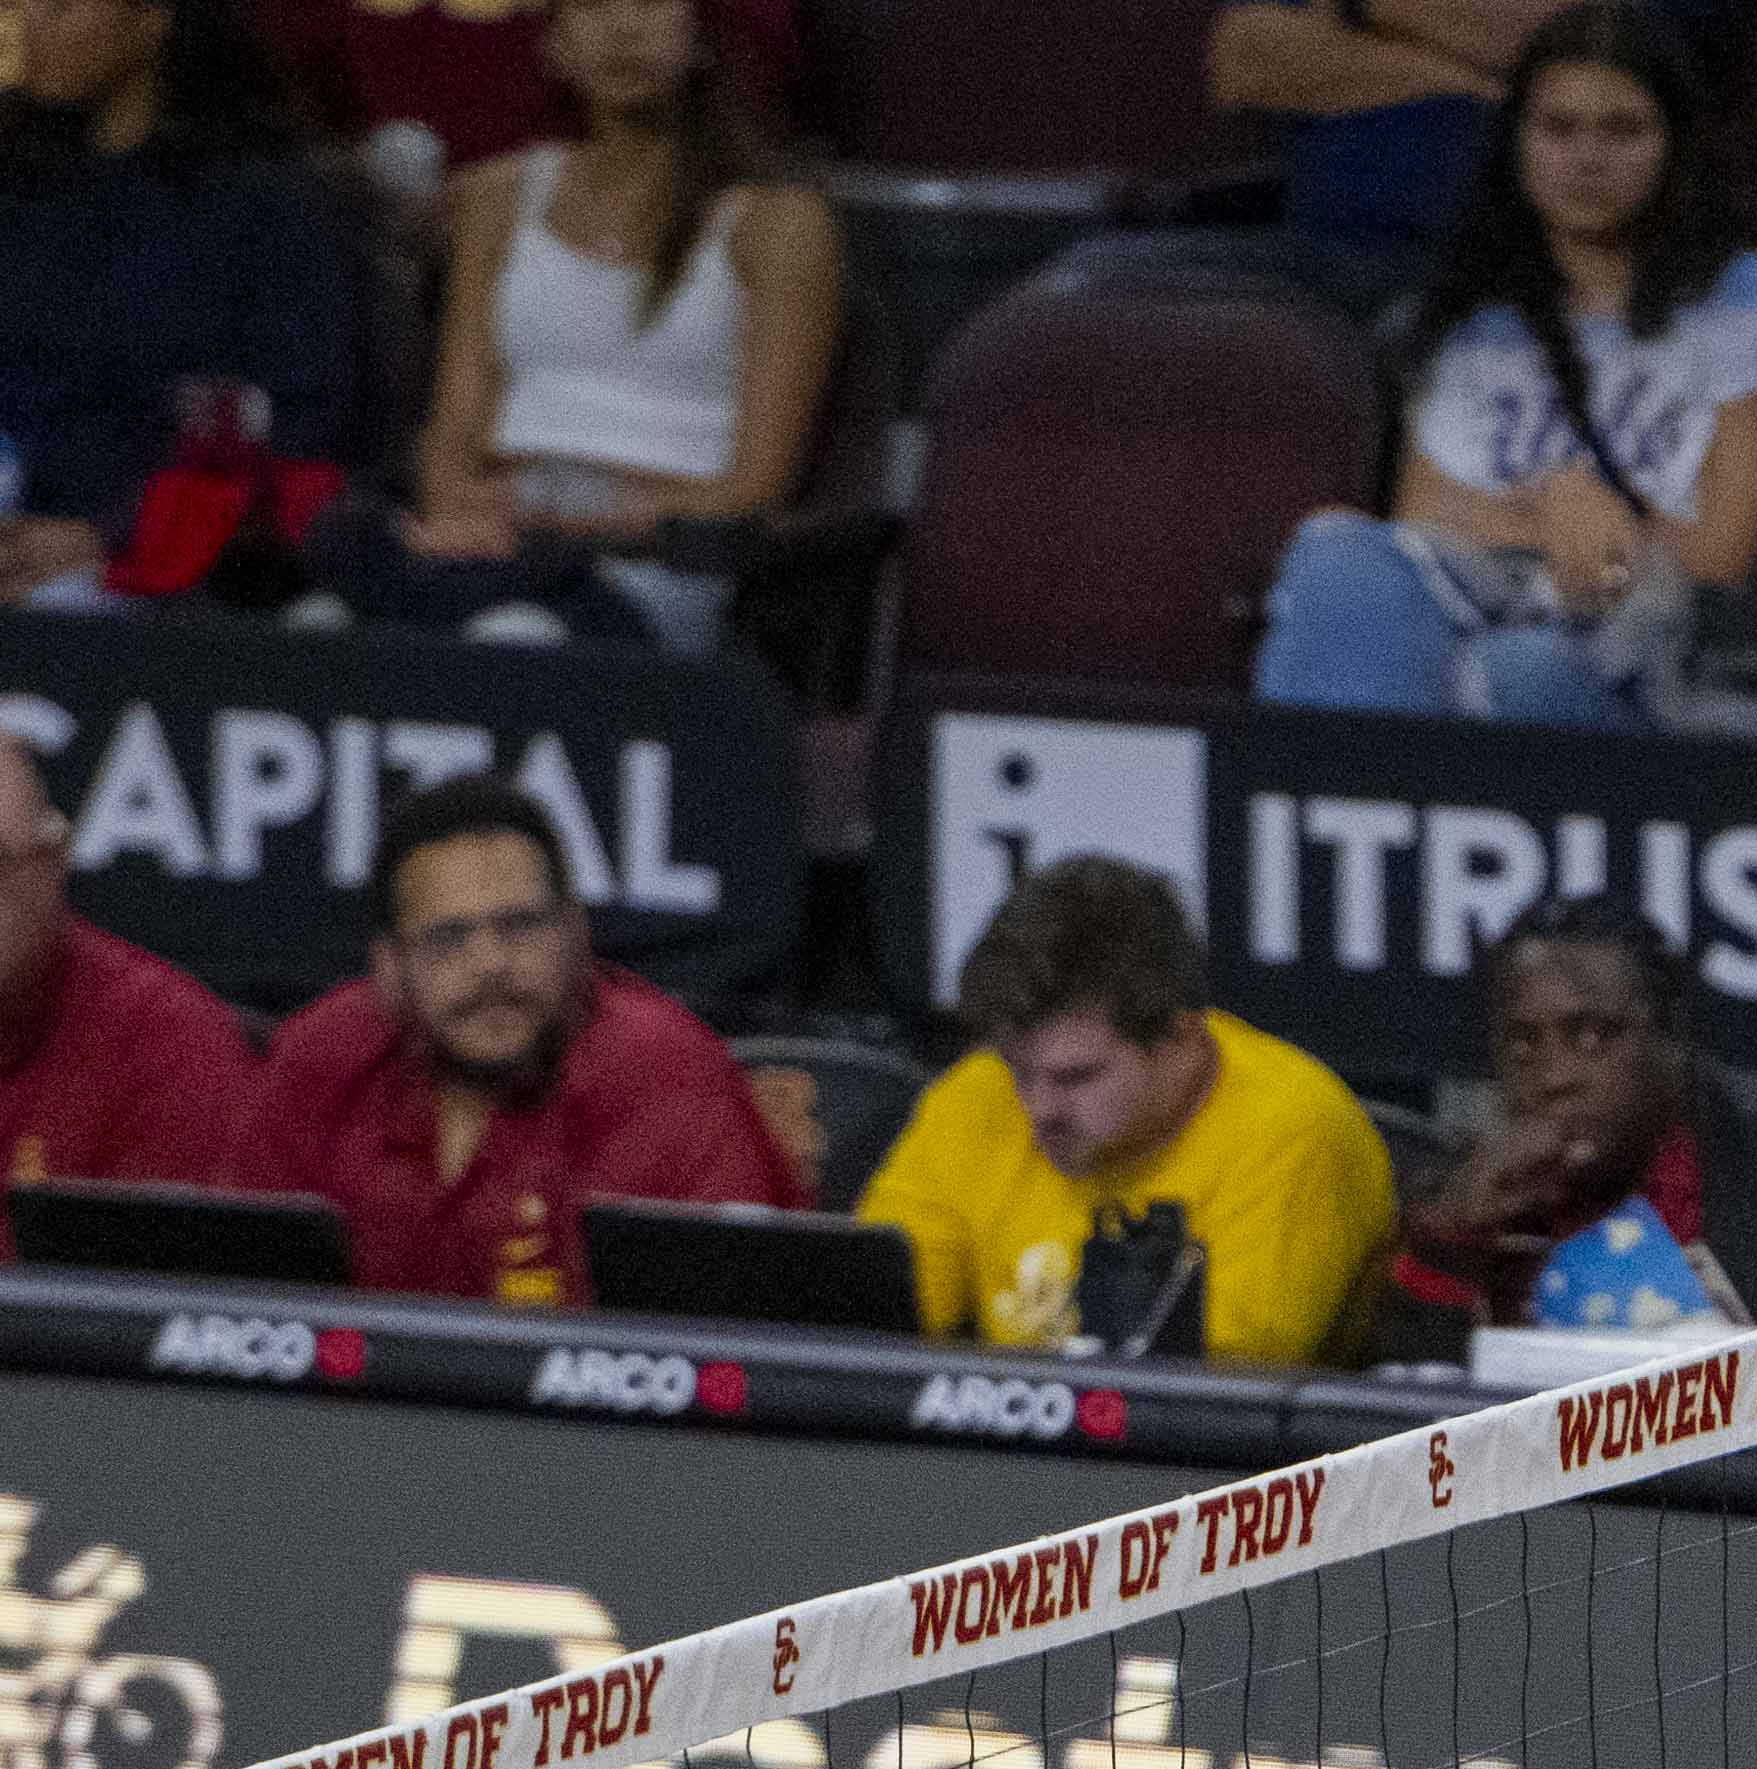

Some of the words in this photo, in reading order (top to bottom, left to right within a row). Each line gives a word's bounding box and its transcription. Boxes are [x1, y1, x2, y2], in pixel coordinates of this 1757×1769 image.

[153, 1314, 315, 1378] ARCO
[533, 1348, 697, 1412] ARCO
[912, 1374, 1075, 1437] ARCO
[1557, 1352, 1740, 1473] WOMEN
[911, 1538, 1096, 1657] WOMEN
[1119, 1512, 1180, 1600] OF
[1197, 1470, 1325, 1575] TROY
[532, 1656, 664, 1768] TROY
